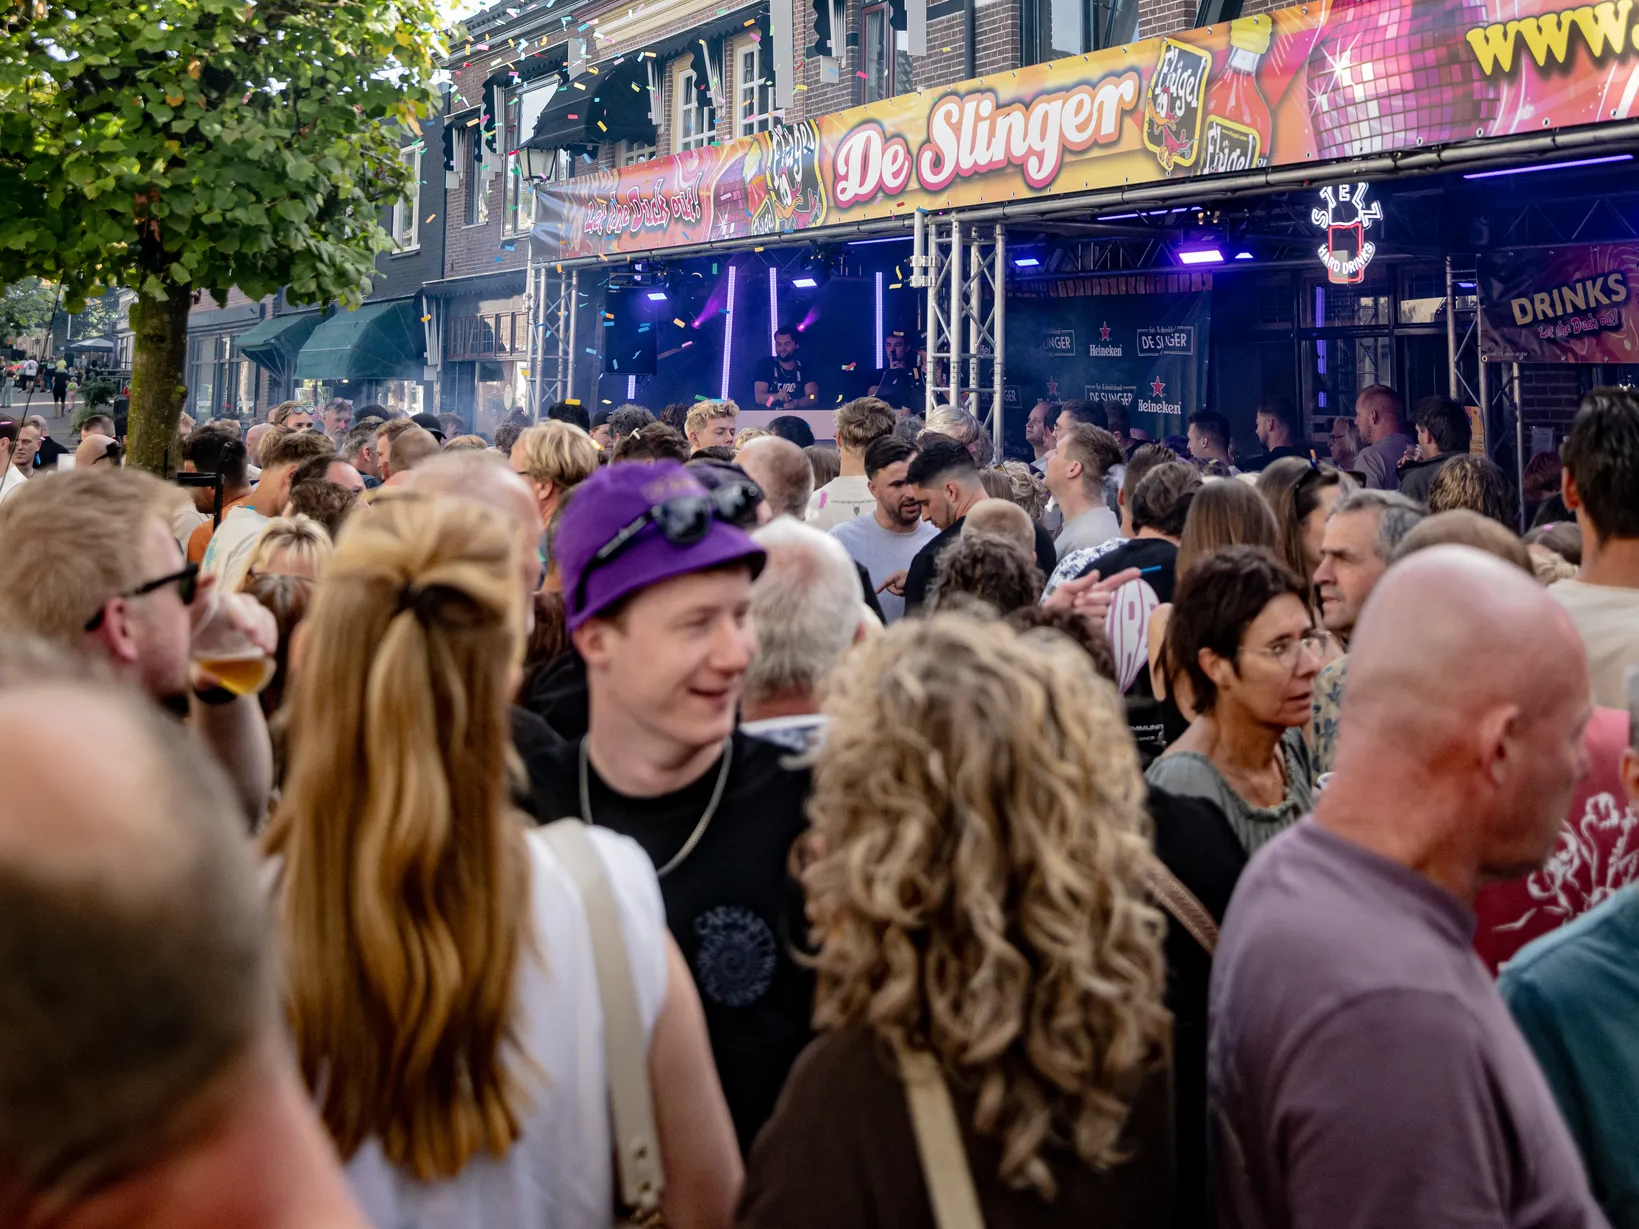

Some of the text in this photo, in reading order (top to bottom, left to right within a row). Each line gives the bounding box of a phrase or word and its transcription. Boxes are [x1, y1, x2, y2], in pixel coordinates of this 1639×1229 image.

[835, 78, 1136, 203] De Slinger
[584, 172, 703, 235] Let the Duck out!
[1311, 182, 1384, 230] STELZ
[1317, 242, 1374, 274] HARD DRINKS
[1511, 273, 1627, 326] DRINKS
[1141, 335, 1155, 349] DE
[1538, 325, 1554, 339] Let
[1555, 320, 1571, 337] the
[1571, 313, 1599, 334] Duck
[1089, 344, 1122, 356] Heineken
[1138, 399, 1182, 414] Heineken
